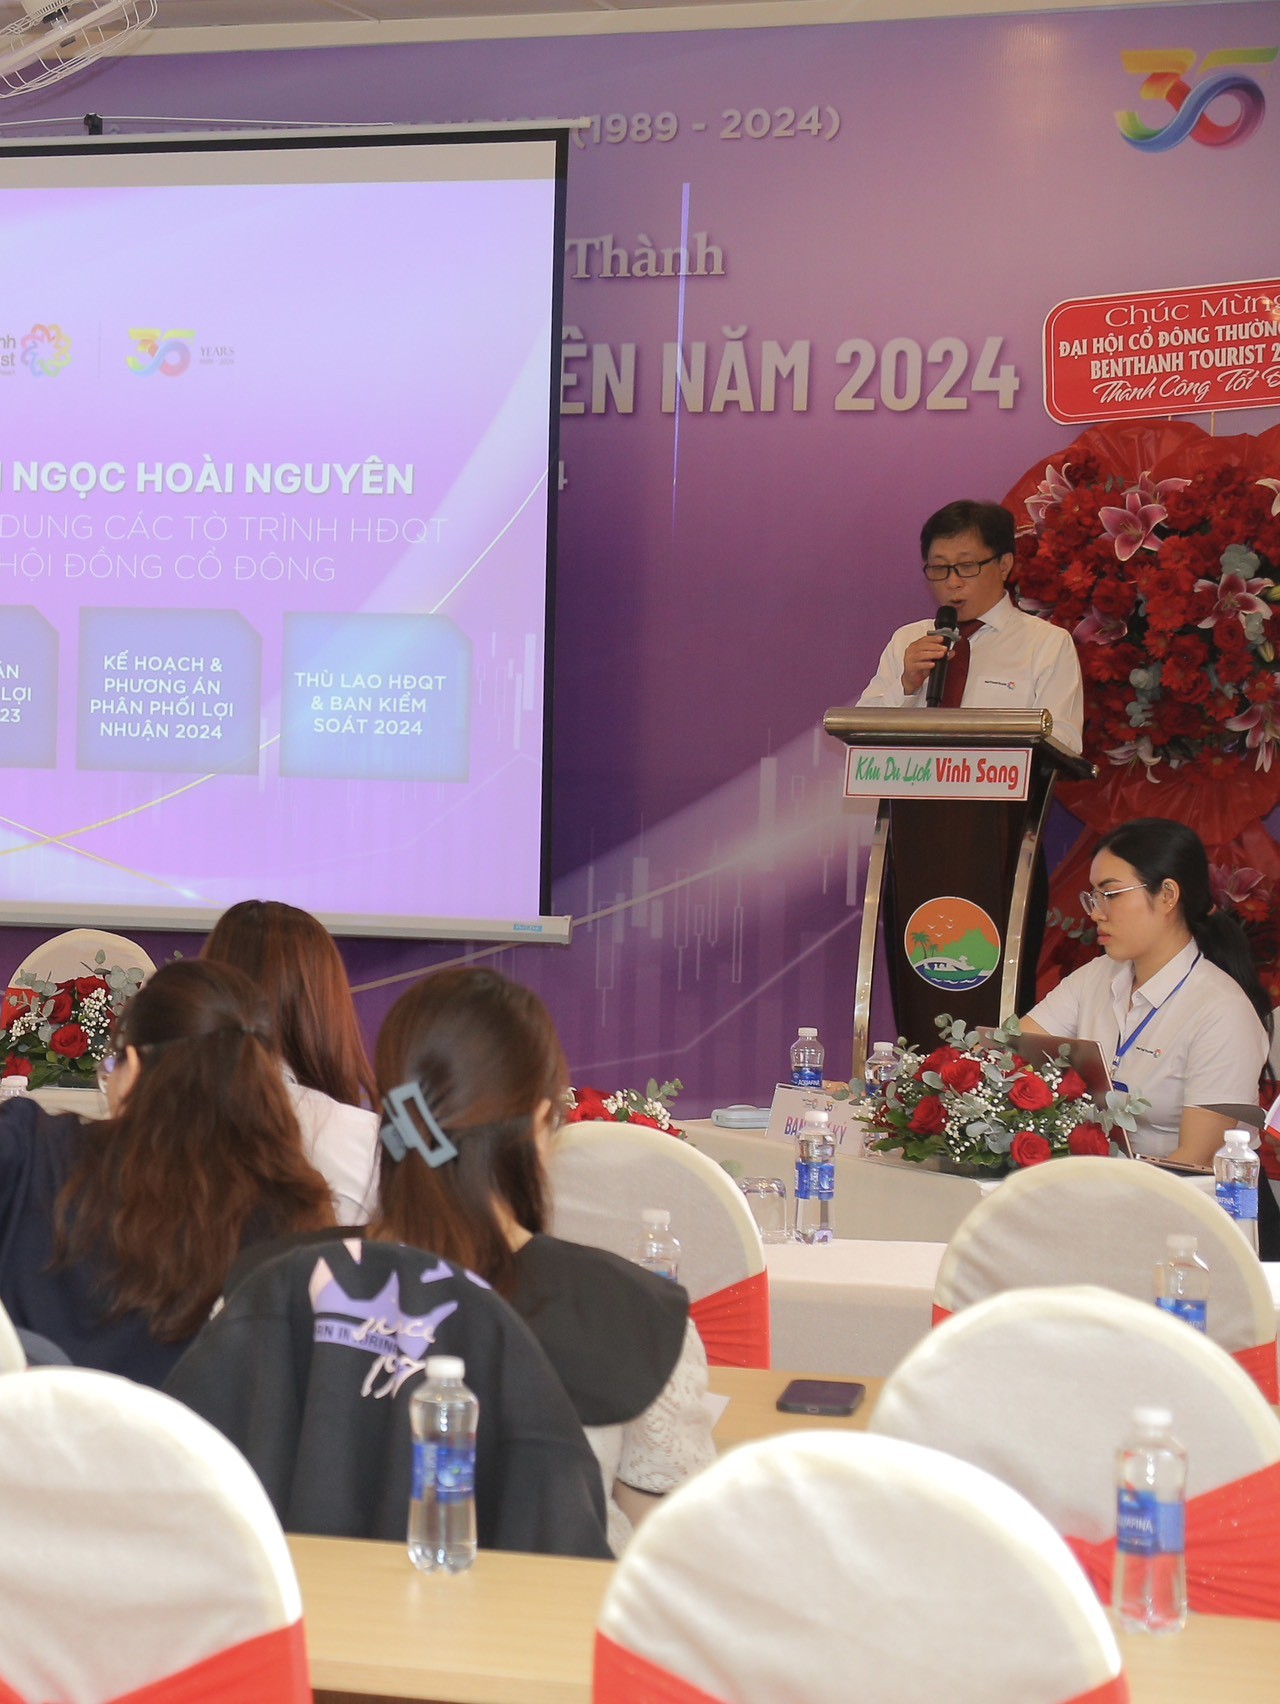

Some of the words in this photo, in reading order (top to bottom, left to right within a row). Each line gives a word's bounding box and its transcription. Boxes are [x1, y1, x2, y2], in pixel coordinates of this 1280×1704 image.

[571, 110, 678, 149] (1989
[691, 121, 708, 132] -
[720, 105, 841, 141] 2024)
[566, 231, 726, 279] Thành
[1106, 301, 1189, 327] Chúc
[1059, 338, 1088, 360] ĐẠI
[1093, 333, 1123, 356] HỘI
[1128, 326, 1154, 350] CỔ
[1158, 326, 1210, 348] ĐÔNG
[1214, 318, 1280, 342] THƯỜN
[560, 325, 636, 415] ÊN
[661, 325, 810, 413] NĂM
[834, 336, 1020, 412] 2024
[1090, 351, 1184, 380] BENTHANH
[1188, 344, 1266, 370] TOURIST
[1092, 377, 1157, 403] Thành
[1159, 375, 1212, 402] Công
[1217, 367, 1259, 392] Tốt
[13, 460, 126, 500] NGỌC
[136, 453, 234, 493] HOÀI
[245, 455, 414, 495] NGUYÊN
[0, 514, 93, 540] DUNG
[105, 510, 174, 541] CÁC
[184, 510, 227, 541] TỜ
[238, 512, 338, 542] TRÌNH
[351, 517, 449, 544] HĐQT
[64, 545, 163, 579] ĐỒNG
[174, 546, 222, 579] CỔ
[234, 552, 336, 582] ĐÔNG
[104, 649, 129, 671] KẾ
[135, 656, 204, 675] HOẠCH
[210, 657, 222, 673] &
[1, 686, 32, 705] LỢI
[104, 677, 186, 694] PHƯƠNG
[192, 676, 220, 695] ÁN
[294, 669, 334, 688] THÙ
[340, 673, 382, 689] LAO
[389, 674, 447, 690] HĐQT
[90, 696, 143, 715] PHÂN
[150, 695, 195, 716] PHỐI
[202, 701, 234, 721] LỢI
[311, 695, 323, 711] &
[331, 696, 371, 712] BAN
[379, 692, 427, 713] KIỂM
[100, 719, 169, 741] NHUẬN
[175, 724, 222, 739] 2024
[313, 715, 368, 734] SOÁT
[374, 720, 423, 735] 2024
[855, 756, 880, 781] Khu
[883, 756, 902, 782] Du
[903, 756, 932, 786] Lịch
[935, 757, 970, 783] Vinh
[976, 759, 1019, 790] Sang
